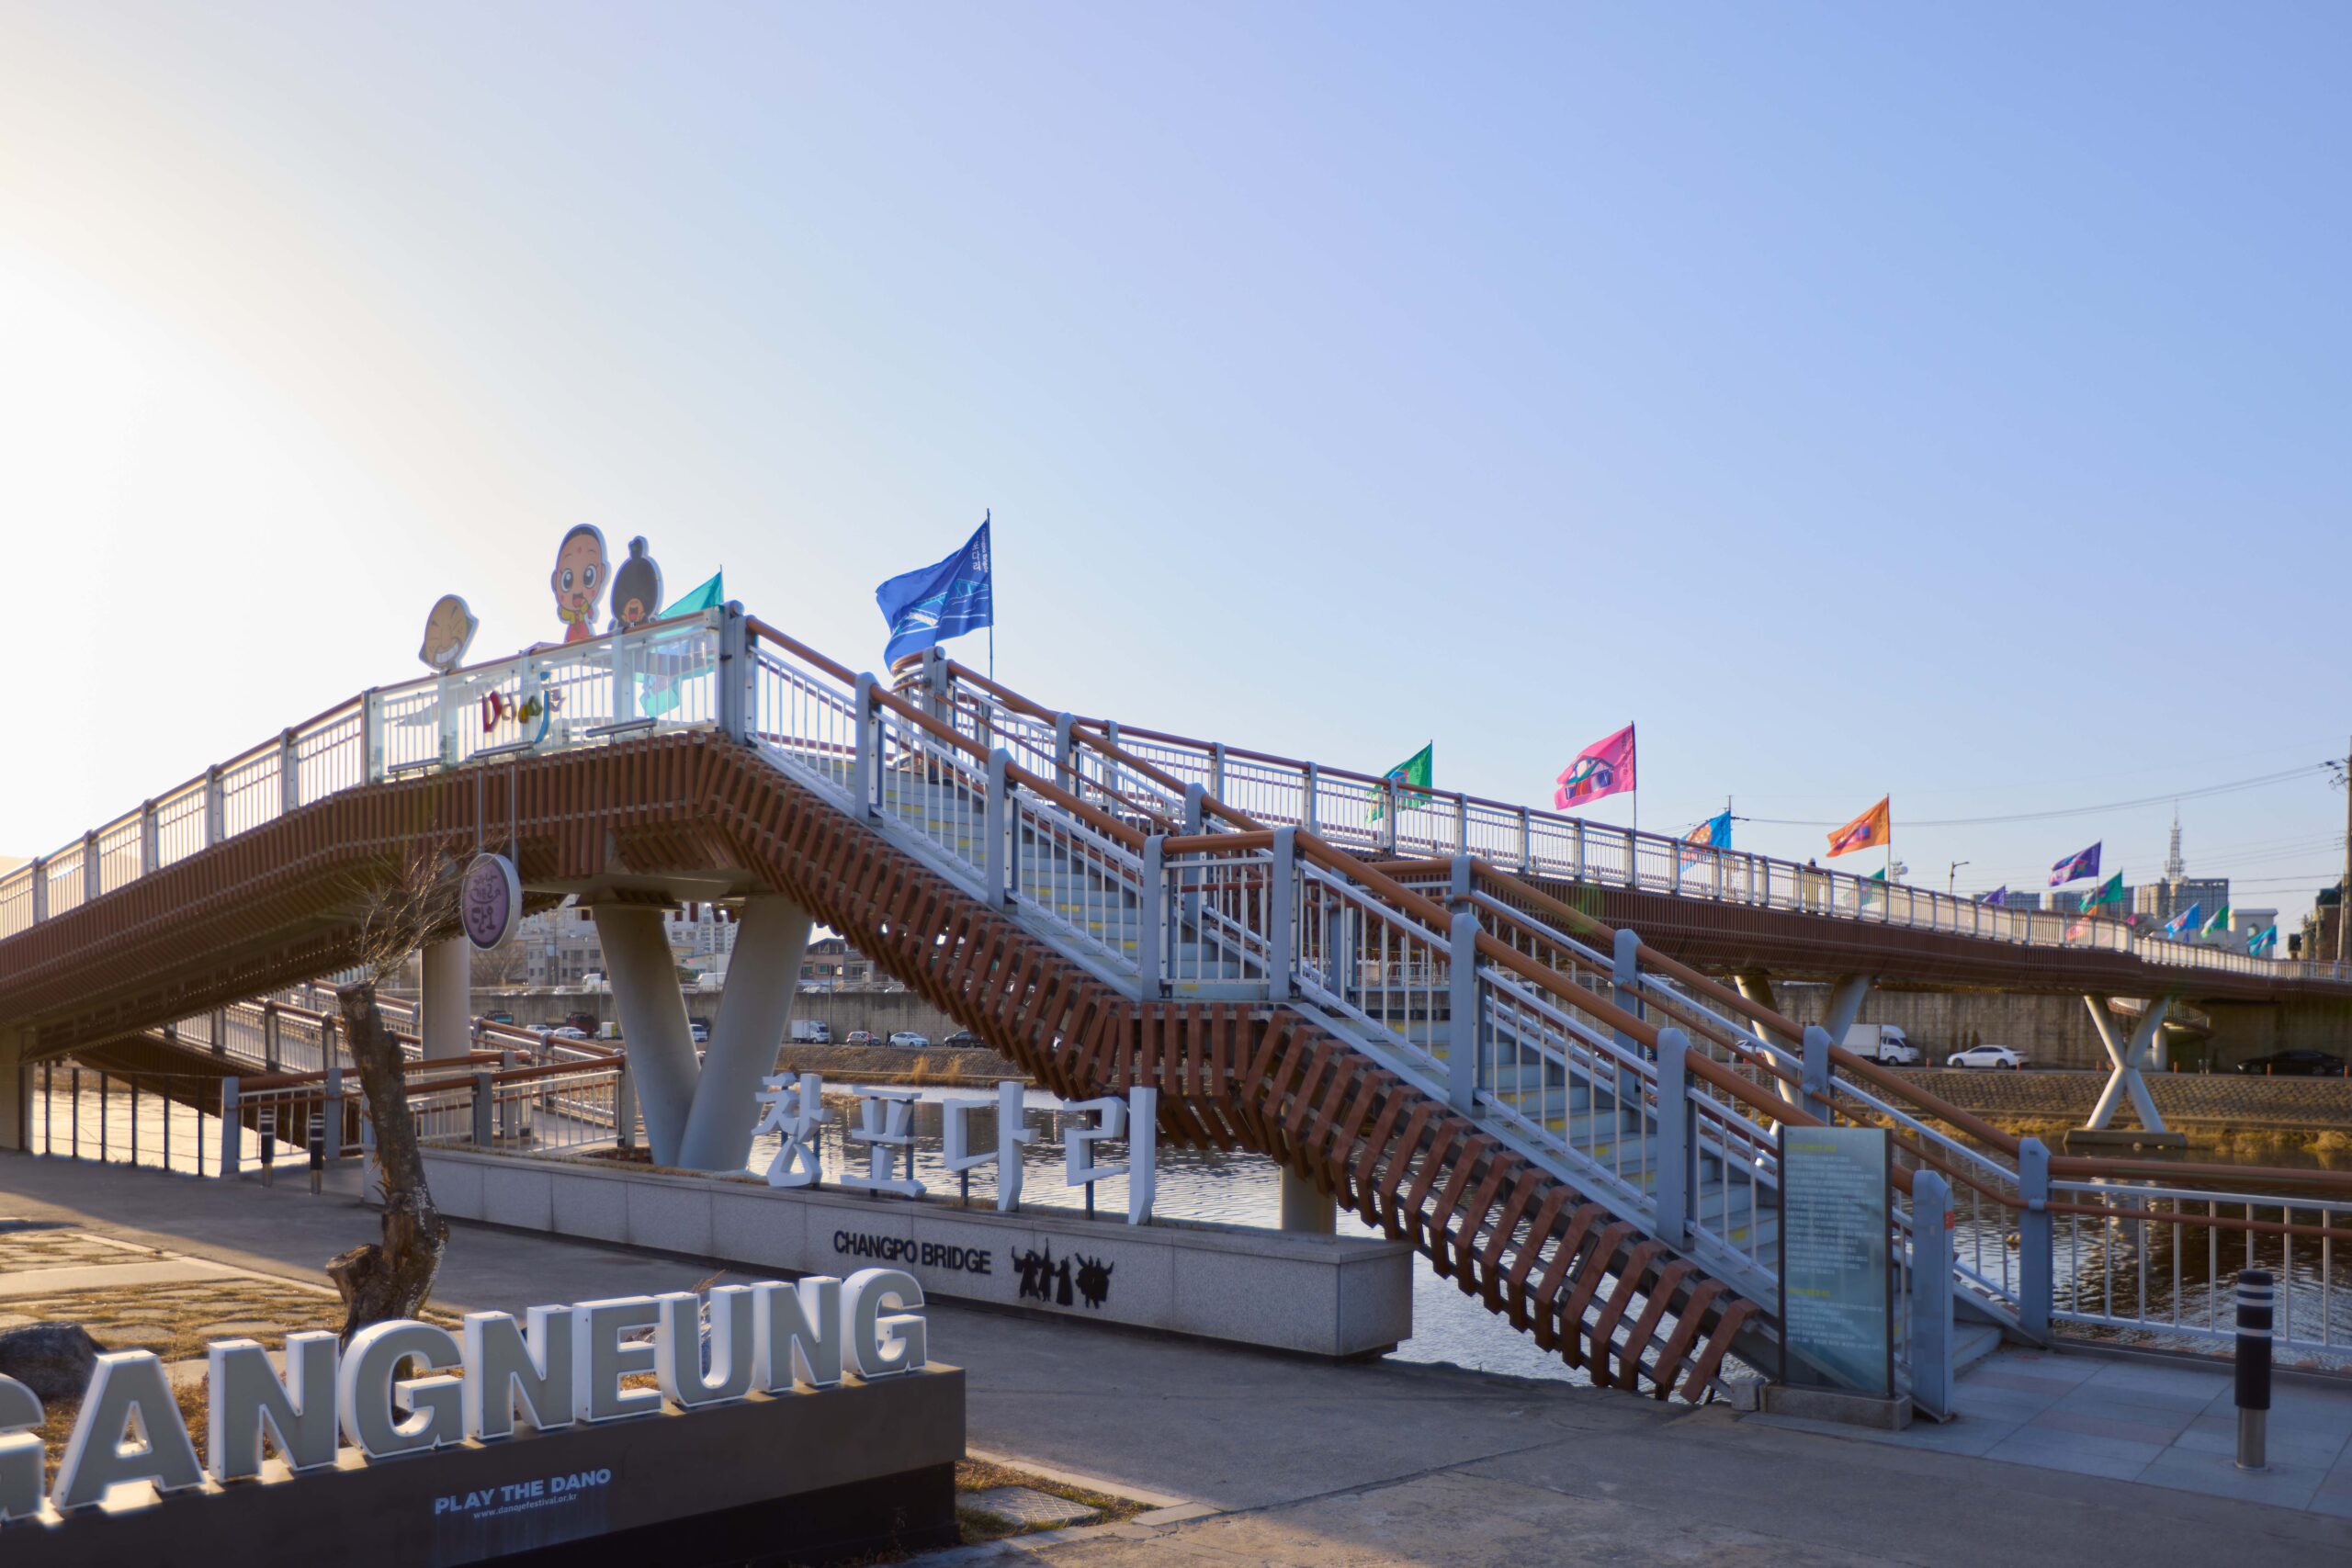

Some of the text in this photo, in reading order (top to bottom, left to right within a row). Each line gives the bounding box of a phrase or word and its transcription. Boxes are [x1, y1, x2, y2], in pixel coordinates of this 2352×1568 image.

[471, 905, 496, 933] 단오
[751, 1072, 1157, 1225] 창포다리
[833, 1230, 992, 1275] CHANGPO BRIDGE
[435, 1468, 612, 1514] PLAY THE DANO
[473, 1493, 577, 1519] www.danojefestival.or.kr
